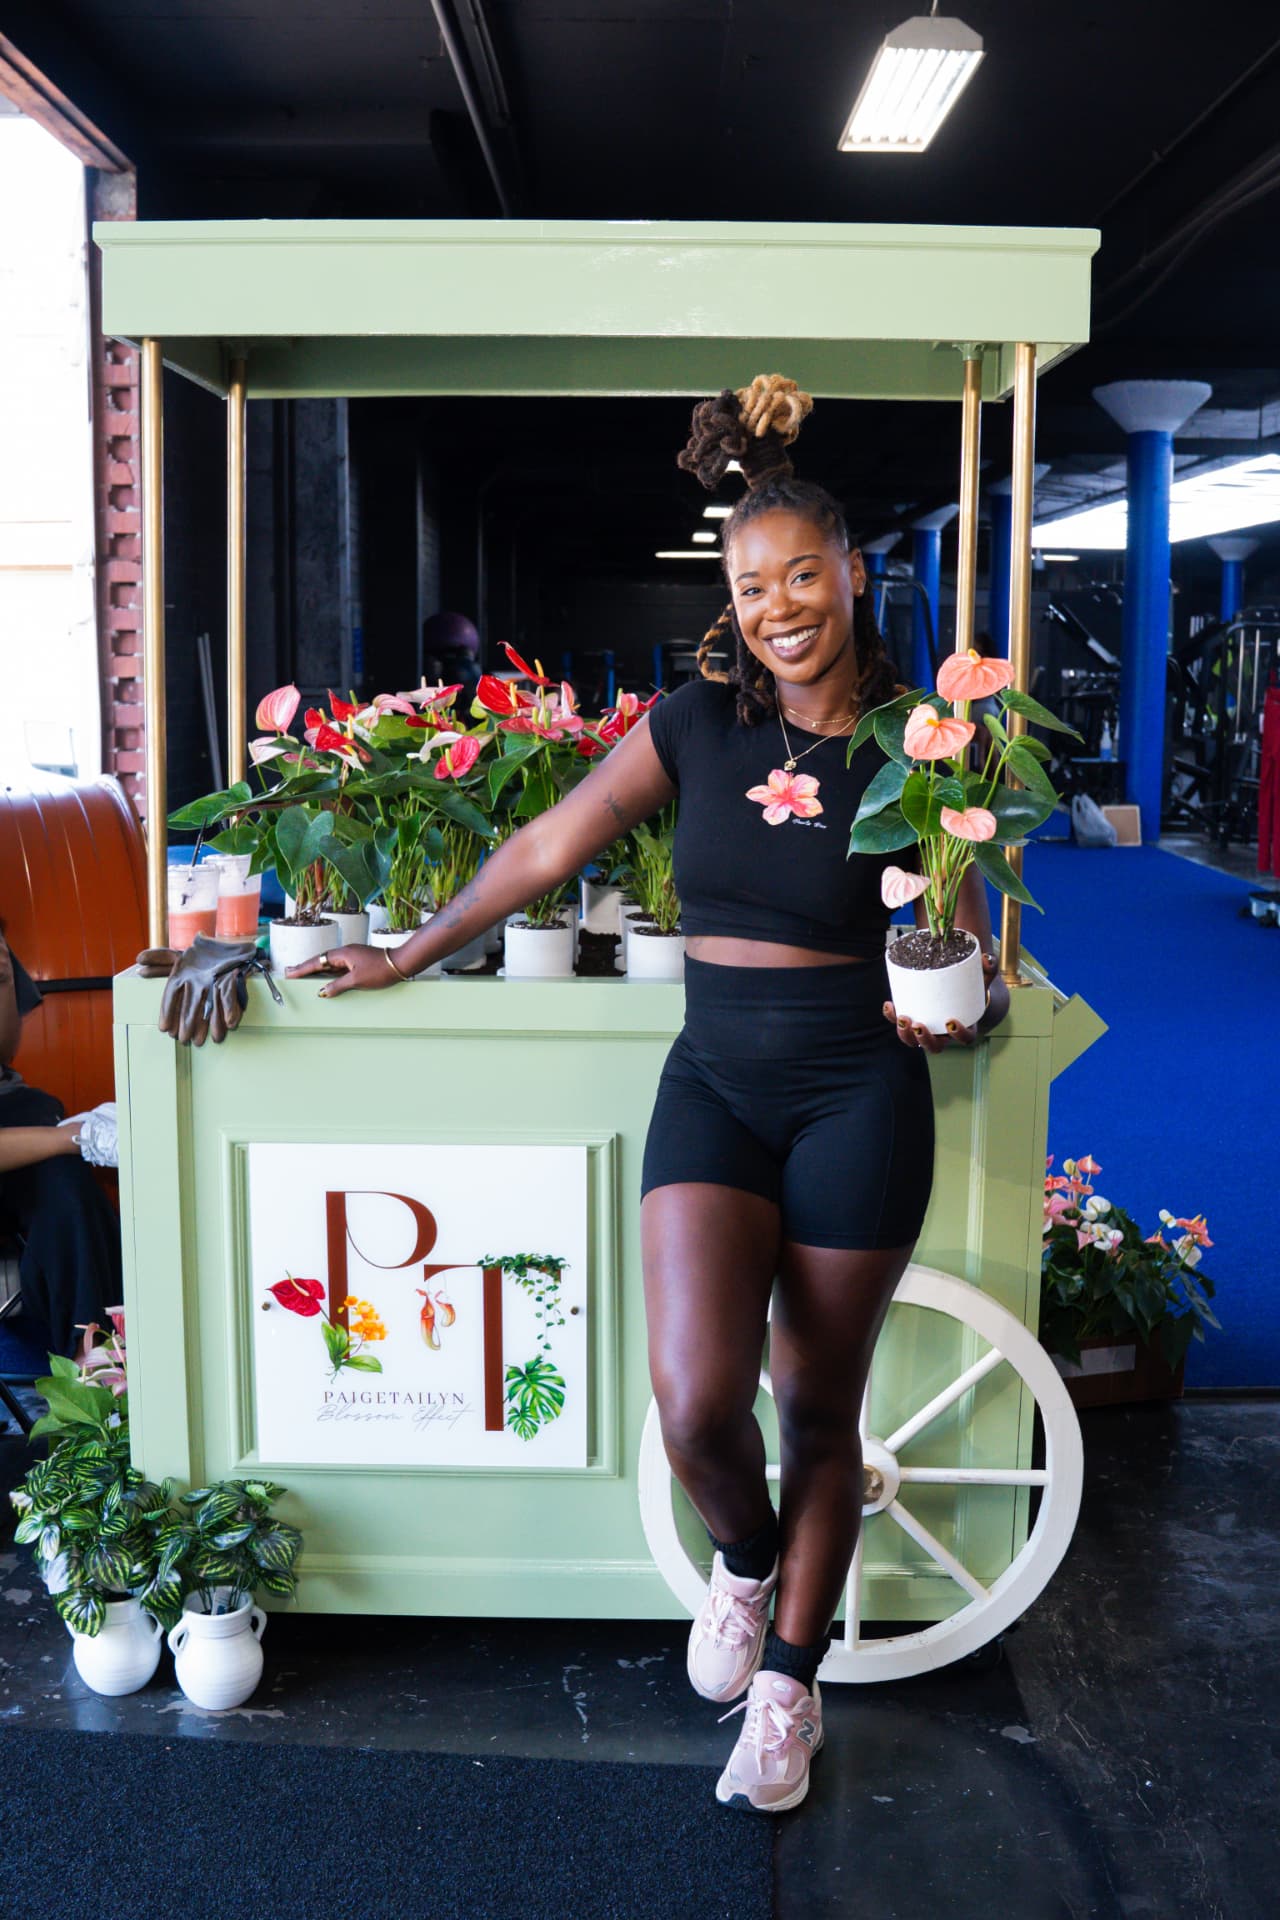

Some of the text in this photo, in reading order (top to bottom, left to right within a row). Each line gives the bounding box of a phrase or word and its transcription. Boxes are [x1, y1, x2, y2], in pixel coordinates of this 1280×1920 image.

[324, 1391, 464, 1405] PAIGETAILYN
[316, 1401, 475, 1431] Blossom Effect
